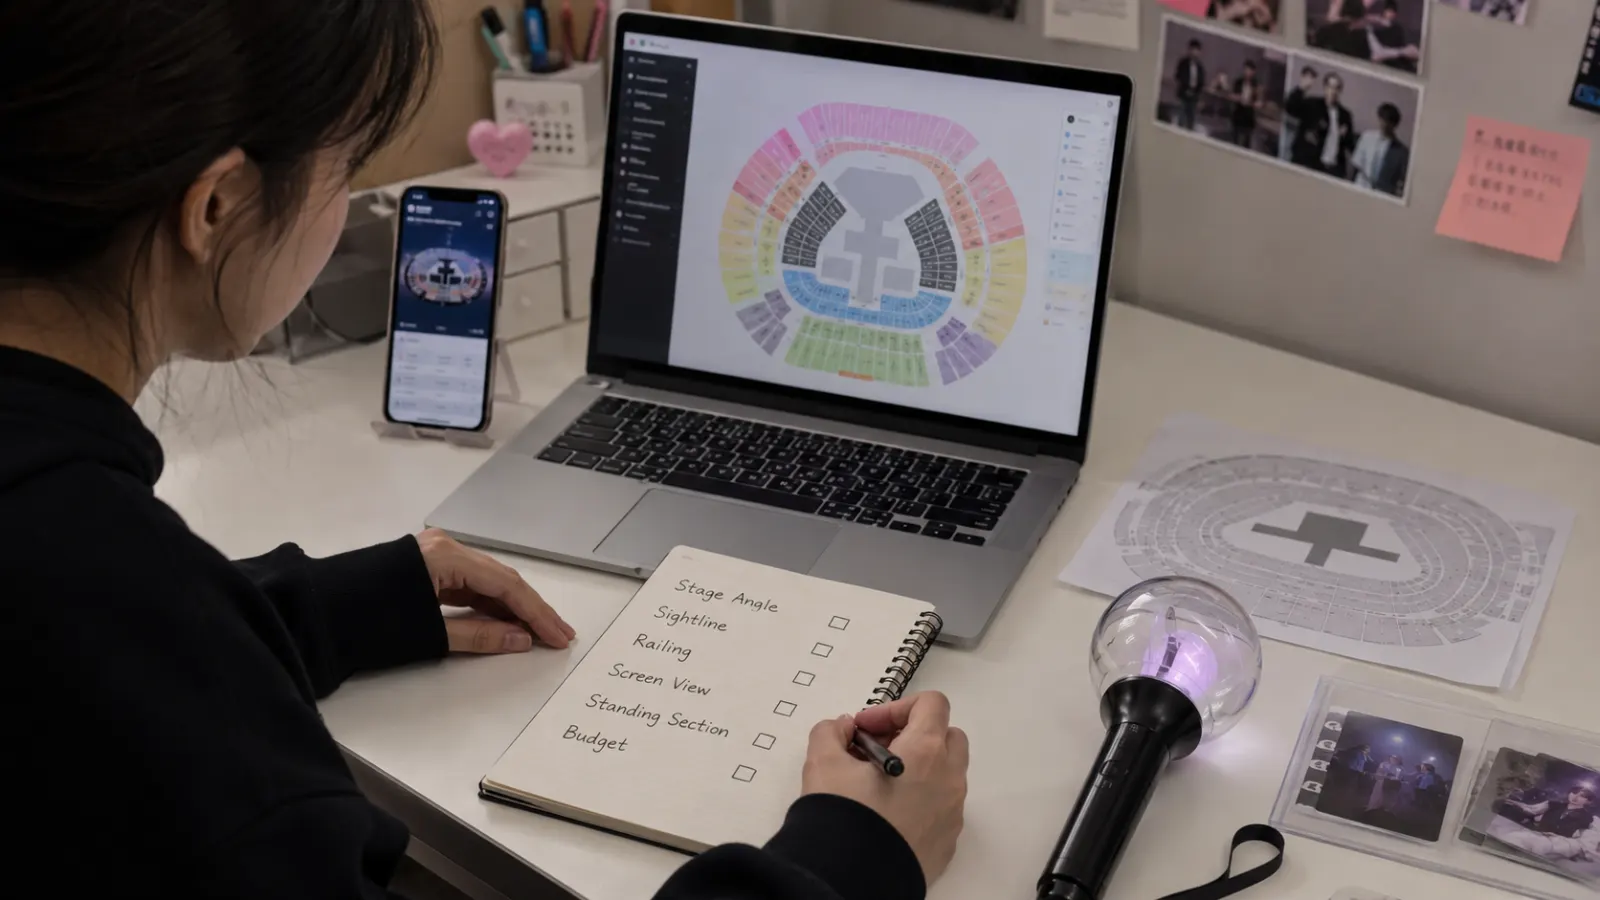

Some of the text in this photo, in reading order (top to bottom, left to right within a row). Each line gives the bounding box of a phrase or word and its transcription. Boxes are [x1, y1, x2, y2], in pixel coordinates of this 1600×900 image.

[674, 579, 778, 612] Stage Angle
[654, 606, 727, 631] Sightline
[633, 633, 692, 662] Railing
[608, 663, 711, 695] Screen View
[585, 694, 729, 737] Standing Section
[563, 725, 628, 753] Budget
